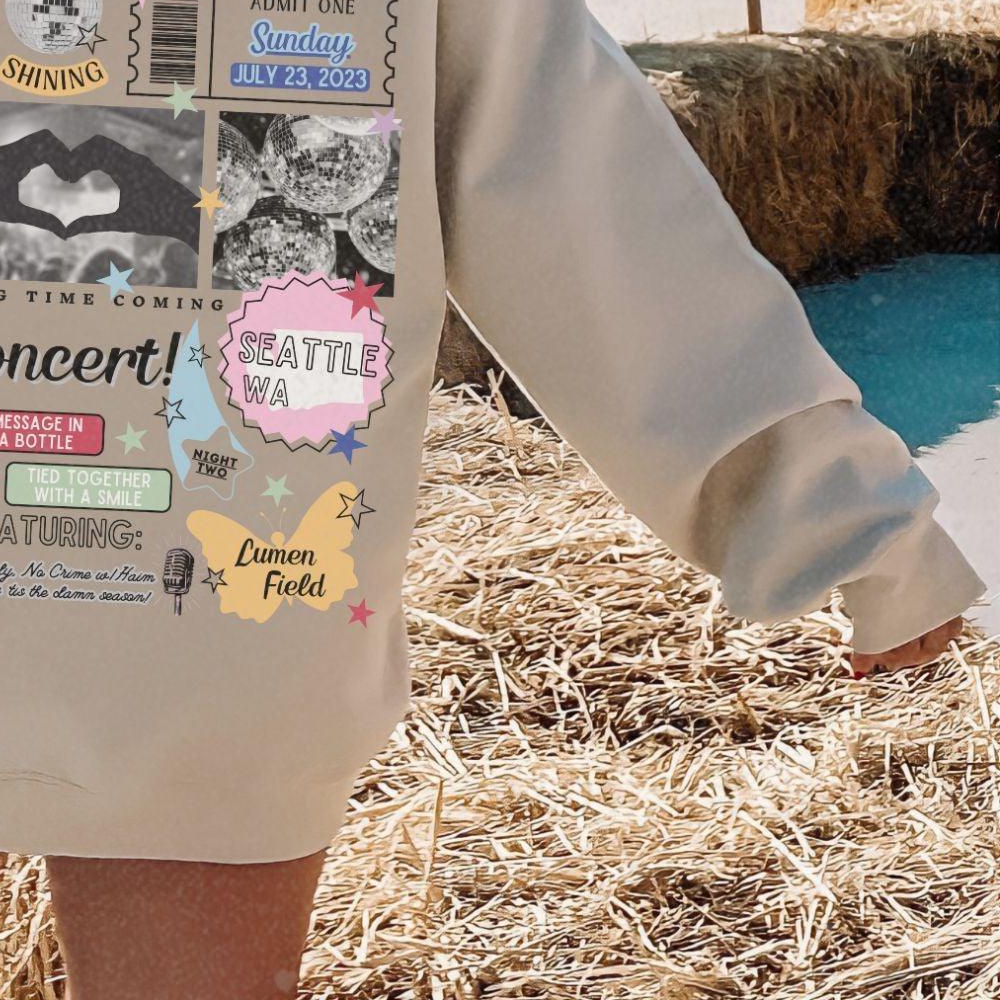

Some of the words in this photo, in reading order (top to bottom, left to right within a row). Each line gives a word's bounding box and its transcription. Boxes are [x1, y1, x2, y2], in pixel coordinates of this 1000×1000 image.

[249, 21, 353, 64] Sunday
[2, 57, 104, 91] SHINING
[233, 64, 278, 84] JULY
[284, 66, 313, 90] 23,
[318, 68, 368, 89] 2023
[26, 290, 95, 306] TIME
[113, 294, 224, 312] COMING
[238, 331, 380, 377] SEATTLE
[243, 374, 290, 407] WA
[68, 417, 84, 433] IN
[14, 433, 74, 450] BOTTLE
[191, 448, 238, 469] NIGHT
[27, 467, 60, 485] TIED
[67, 469, 151, 489] TOGETHER
[196, 462, 229, 480] TWO
[34, 487, 74, 504] WITH
[80, 490, 91, 505] A
[97, 490, 143, 507] SMILE
[234, 538, 317, 568] Lumen
[21, 561, 46, 578] No
[50, 563, 92, 580] Crime
[29, 583, 50, 598] the
[53, 585, 96, 600] damn
[98, 591, 153, 605] season!
[263, 569, 327, 600] Field
